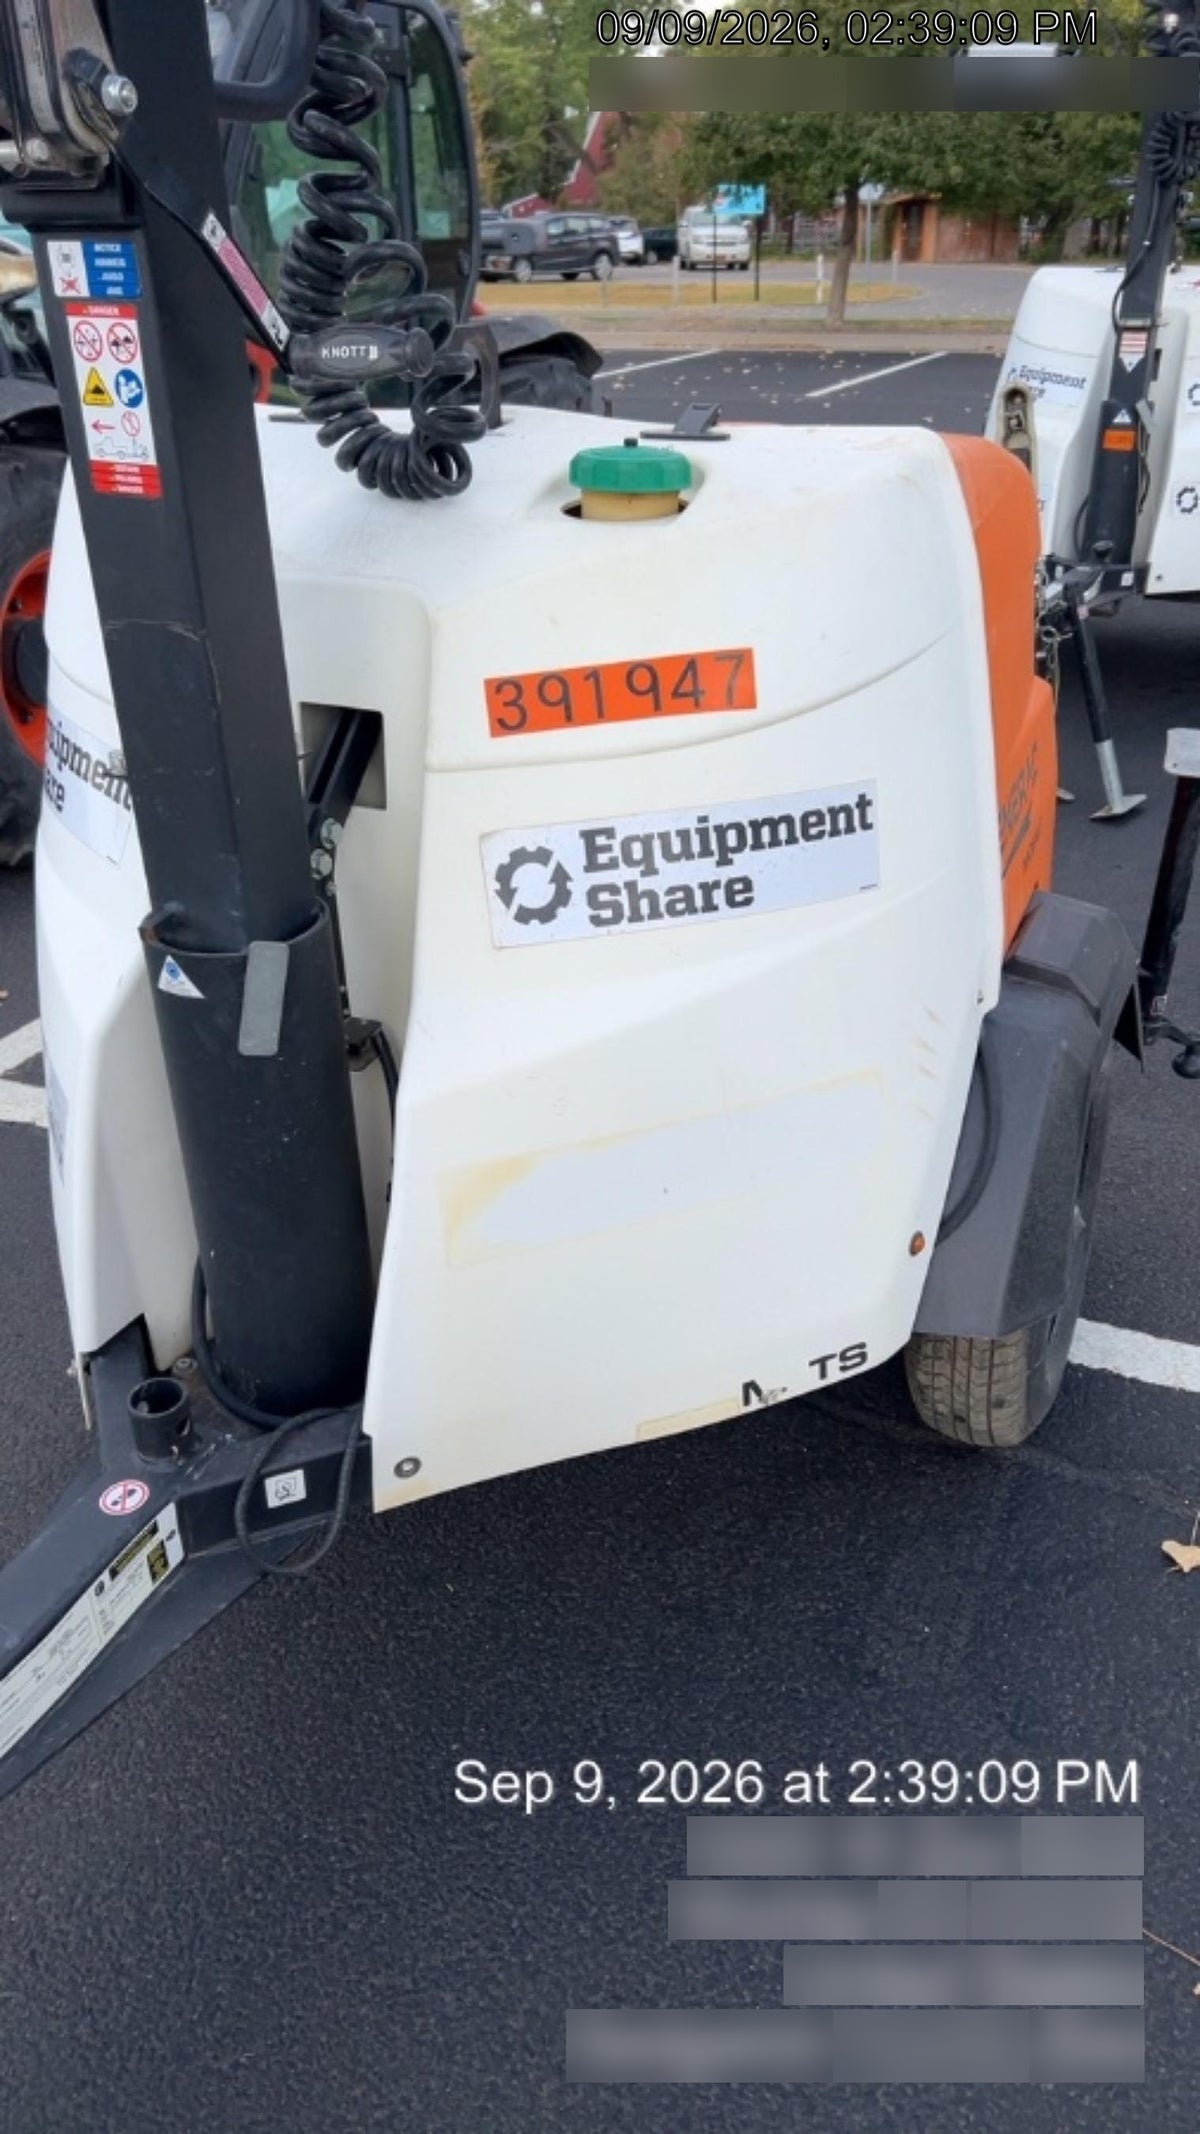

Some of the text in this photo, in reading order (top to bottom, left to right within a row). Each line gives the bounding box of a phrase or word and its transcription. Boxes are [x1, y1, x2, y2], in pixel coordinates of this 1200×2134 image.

[321, 345, 367, 359] KNOTT
[494, 653, 745, 732] 391947
[579, 793, 874, 877] Equipment
[586, 875, 756, 928] Share
